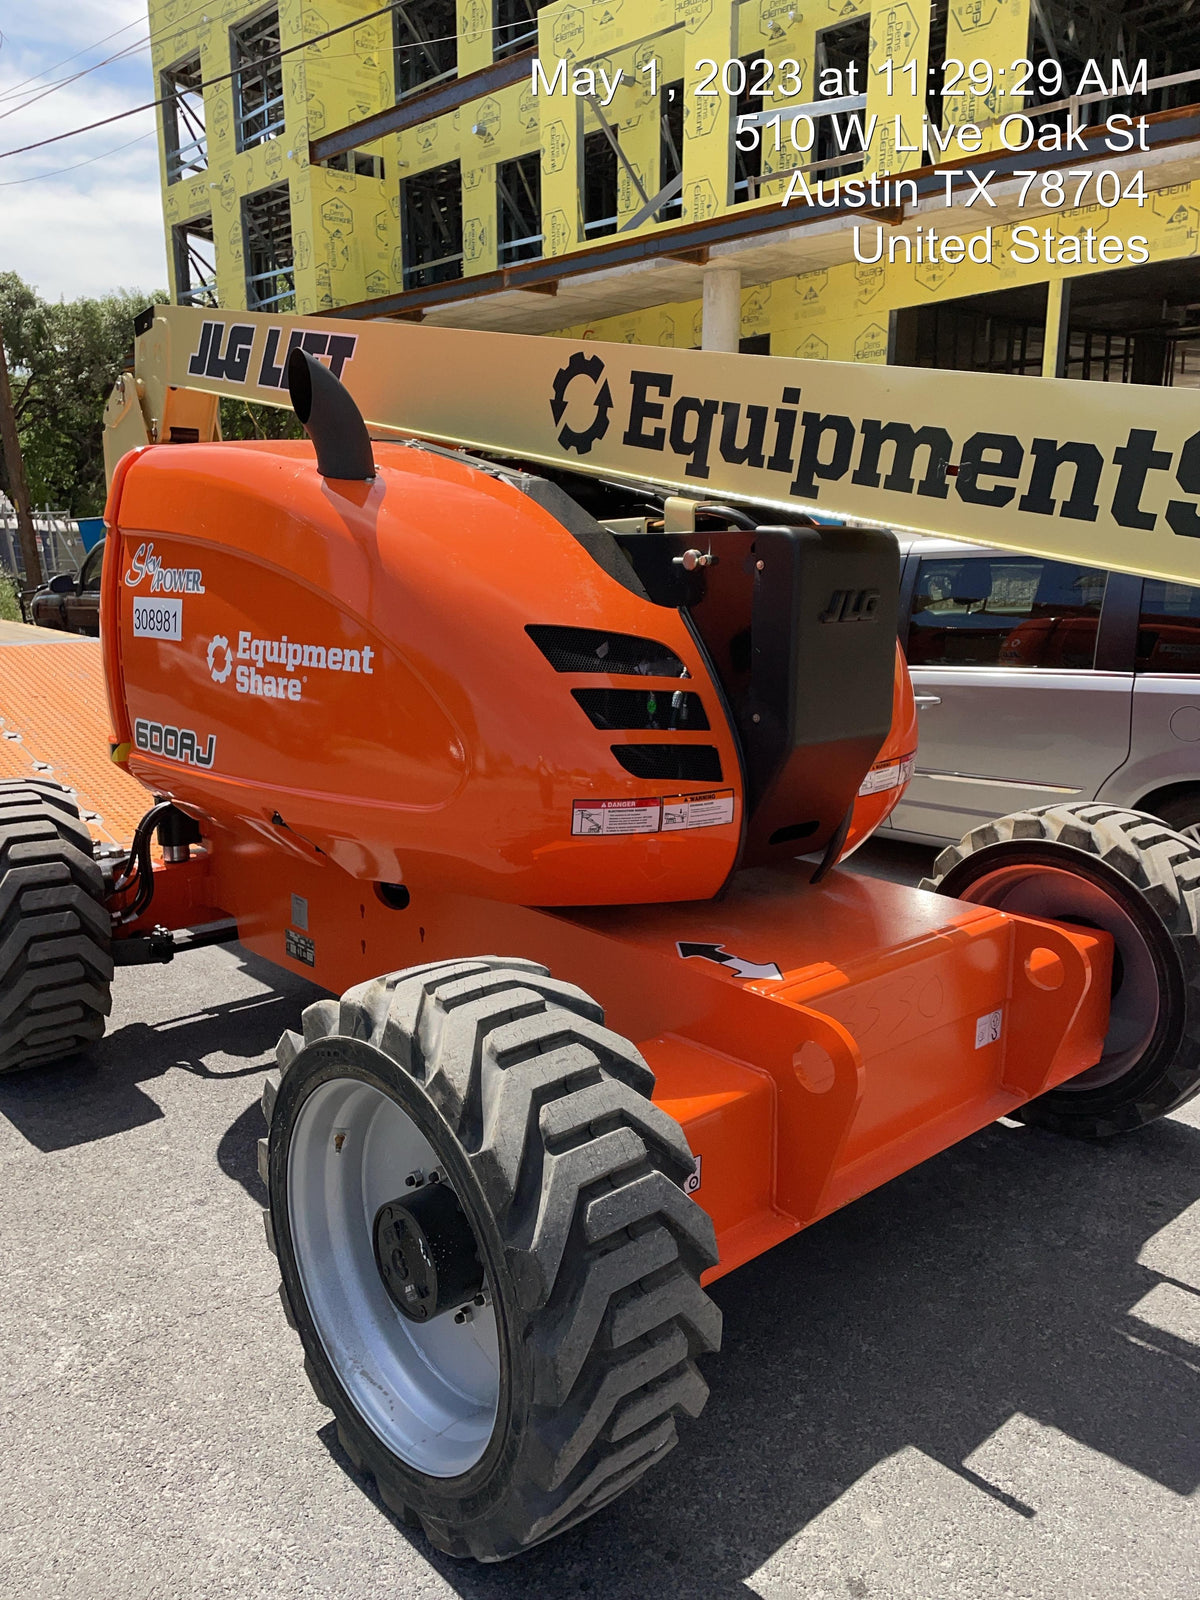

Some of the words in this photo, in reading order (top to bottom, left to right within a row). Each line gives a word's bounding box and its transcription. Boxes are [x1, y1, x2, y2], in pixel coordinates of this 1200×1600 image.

[187, 320, 257, 384] JLG
[134, 608, 177, 633] 308981
[236, 630, 375, 674] Equipment
[134, 717, 217, 769] 600AJ
